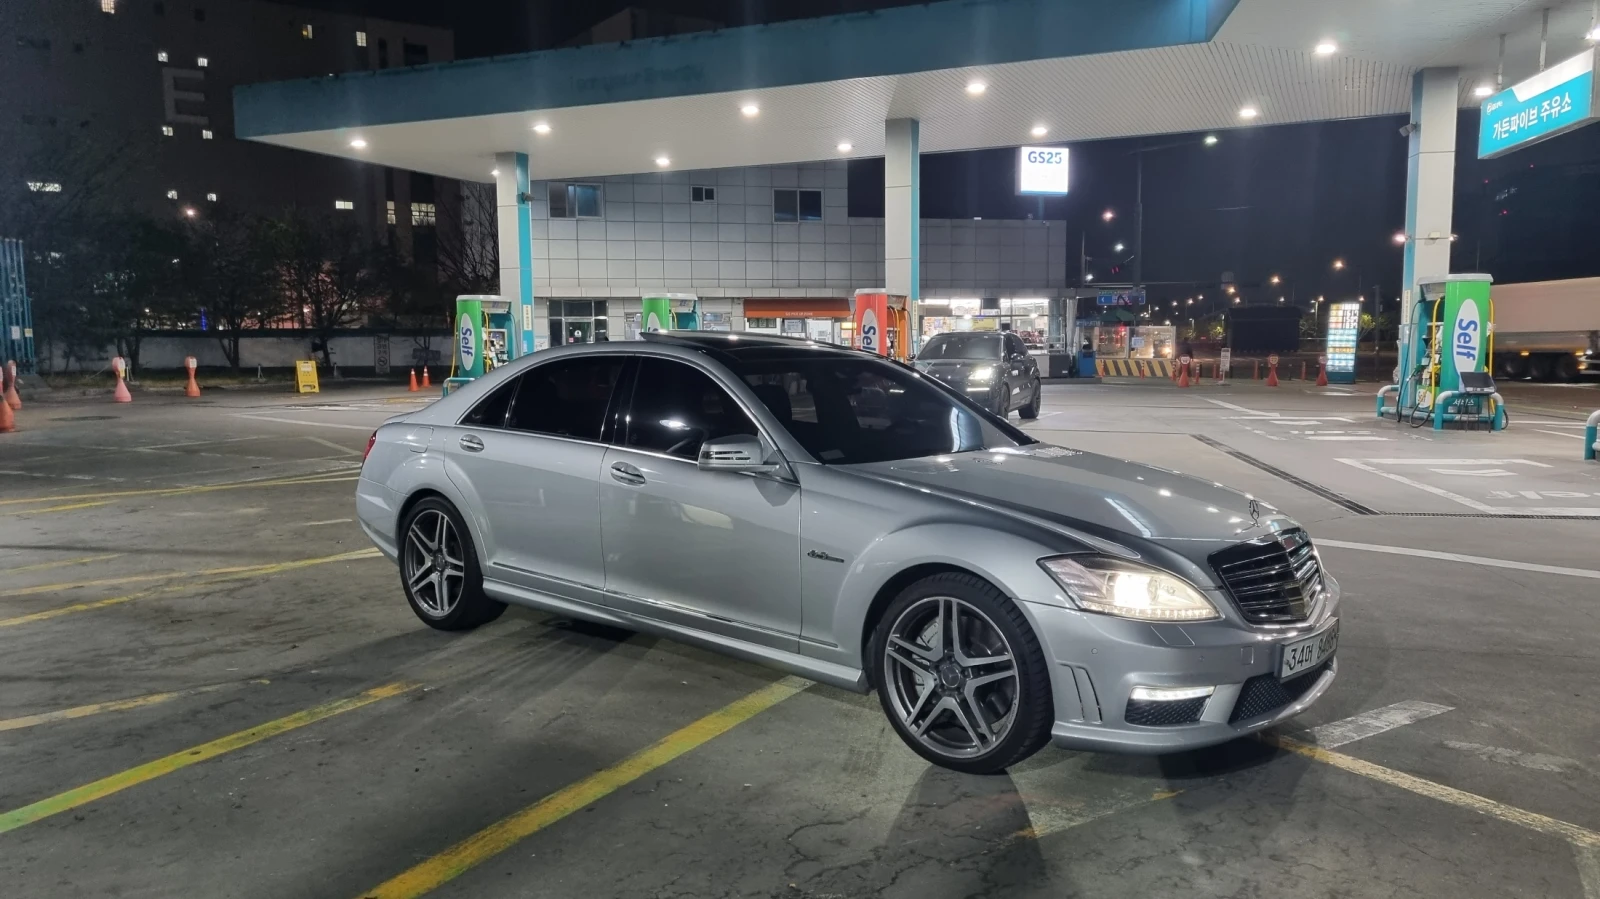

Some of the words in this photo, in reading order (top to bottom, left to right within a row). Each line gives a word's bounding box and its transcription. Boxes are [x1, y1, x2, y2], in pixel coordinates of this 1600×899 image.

[162, 67, 209, 125] E
[1492, 106, 1538, 141] 가든파이브
[1540, 92, 1572, 122] 주유소
[1028, 151, 1062, 164] GS25
[461, 327, 473, 357] Self
[862, 325, 876, 350] Sel
[1456, 318, 1478, 361] Self
